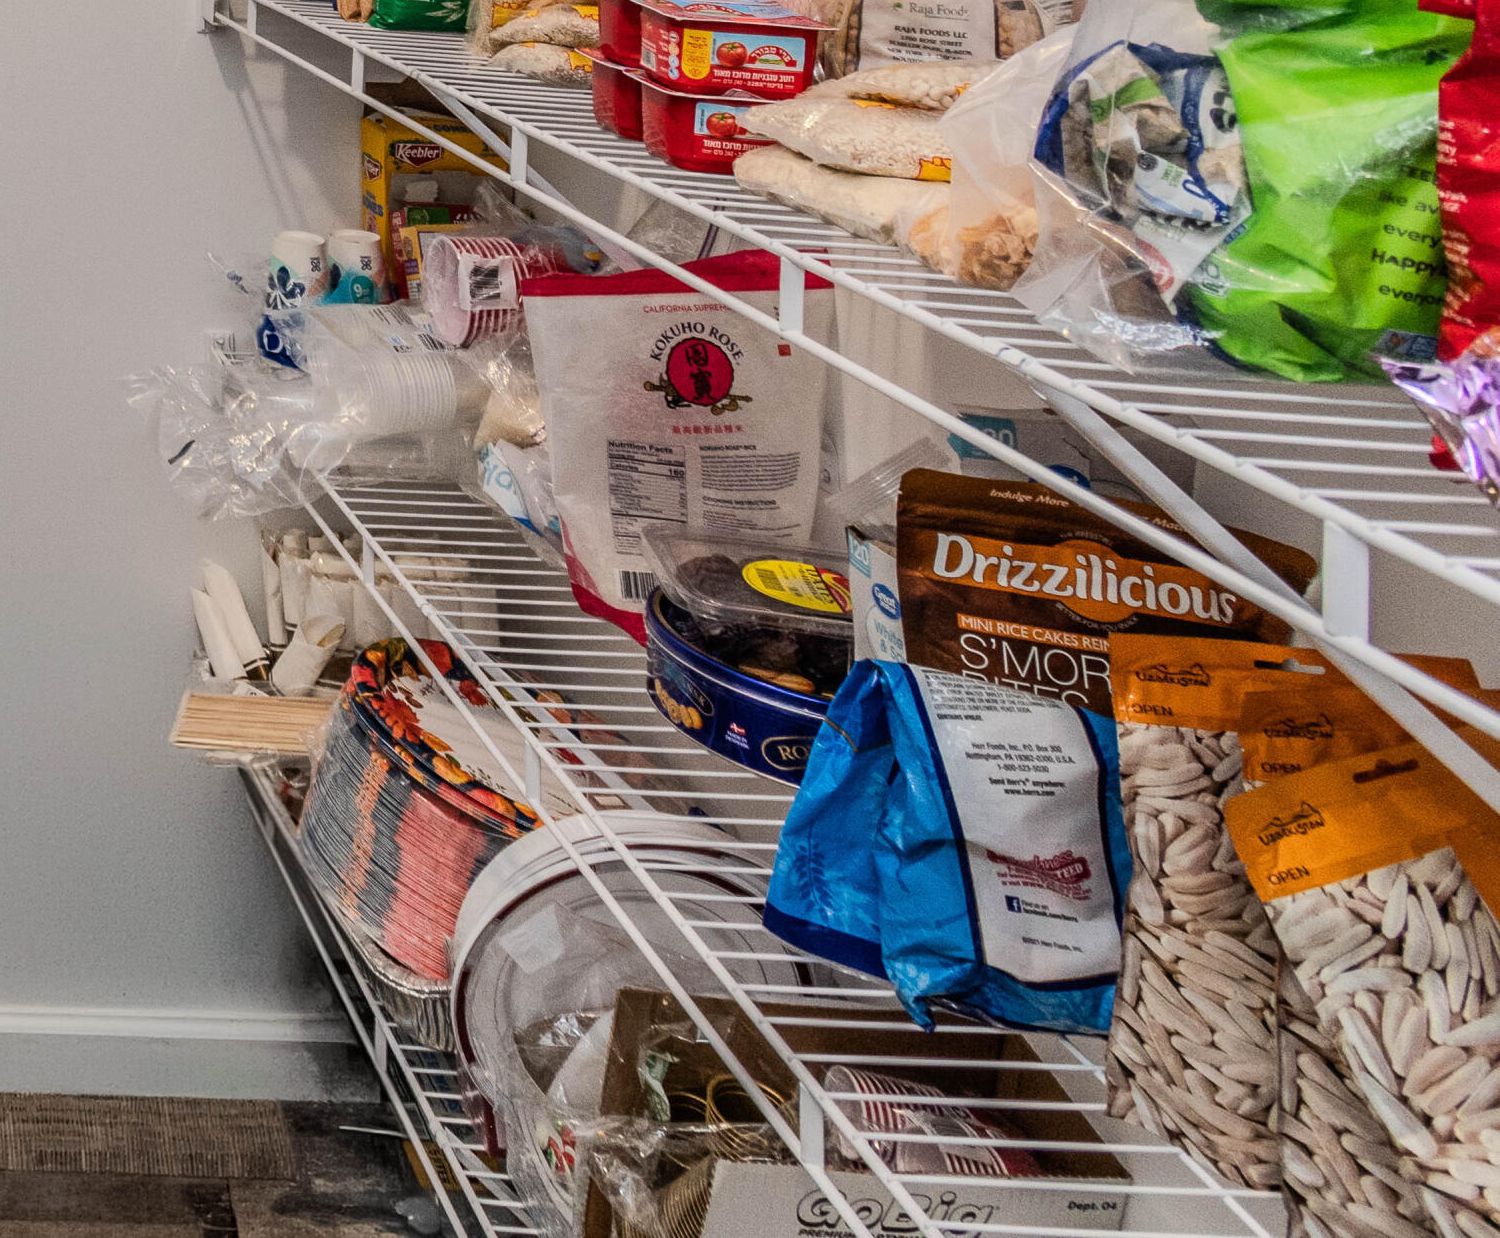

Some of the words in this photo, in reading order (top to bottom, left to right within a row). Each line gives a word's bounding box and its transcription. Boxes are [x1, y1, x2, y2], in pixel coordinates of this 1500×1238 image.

[909, 2, 934, 16] Raja
[937, 3, 969, 17] Foods
[895, 25, 916, 34] RAJA
[920, 28, 950, 38] FOODS
[397, 144, 440, 161] Keebler
[353, 283, 363, 297] 9
[643, 304, 692, 313] CALIFORNIA
[650, 322, 705, 361] KOKUHO
[709, 326, 745, 362] ROSE
[608, 441, 647, 452] Nutrition
[649, 444, 673, 454] Facts
[668, 468, 685, 477] 160
[990, 488, 1033, 504] Indulge
[1036, 494, 1070, 507] More
[932, 533, 1238, 625] Drizzilicious
[961, 616, 993, 632] MINI
[996, 622, 1029, 639] RICE
[1032, 629, 1079, 647] CAKES
[1132, 703, 1174, 719] OPEN
[1261, 762, 1303, 775] OPEN
[1267, 866, 1311, 887] OPEN
[1067, 1200, 1098, 1213] Dept.
[1102, 1200, 1118, 1212] 04
